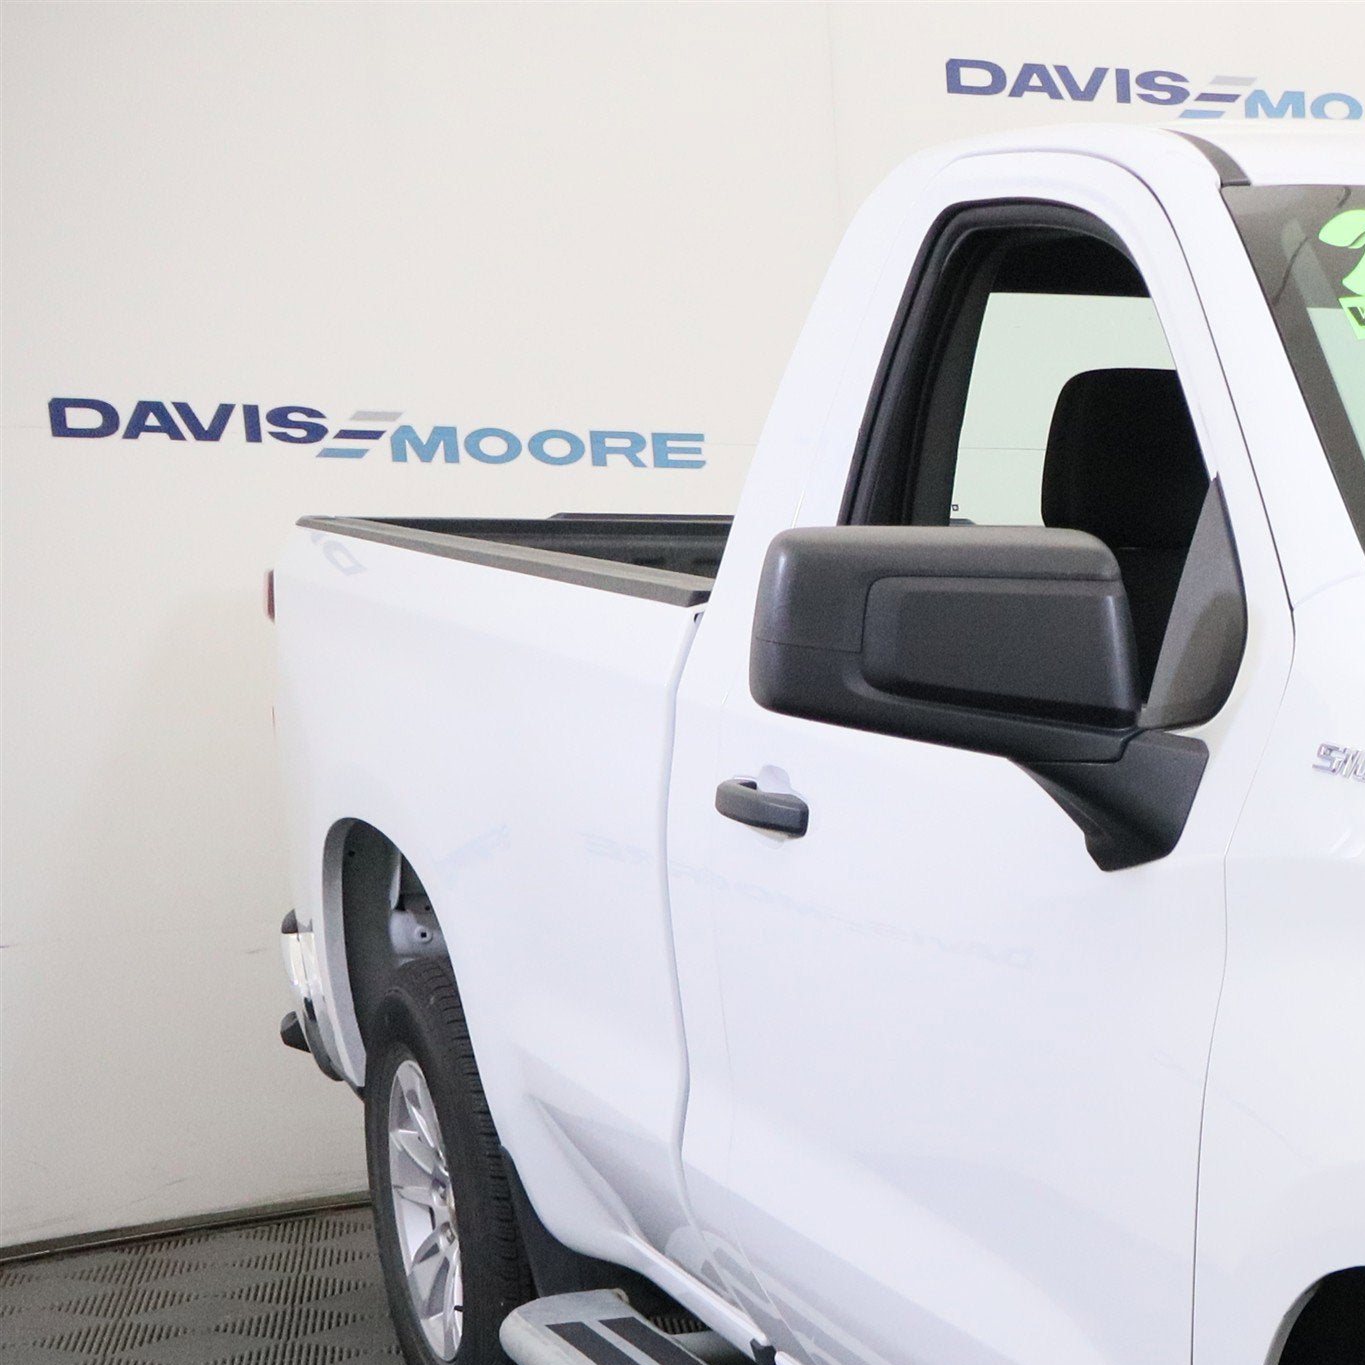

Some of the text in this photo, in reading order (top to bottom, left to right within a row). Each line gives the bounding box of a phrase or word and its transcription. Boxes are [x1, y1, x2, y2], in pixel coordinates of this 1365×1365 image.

[945, 58, 1190, 105] DAVIS
[48, 397, 706, 470] DAVIS MOORE
